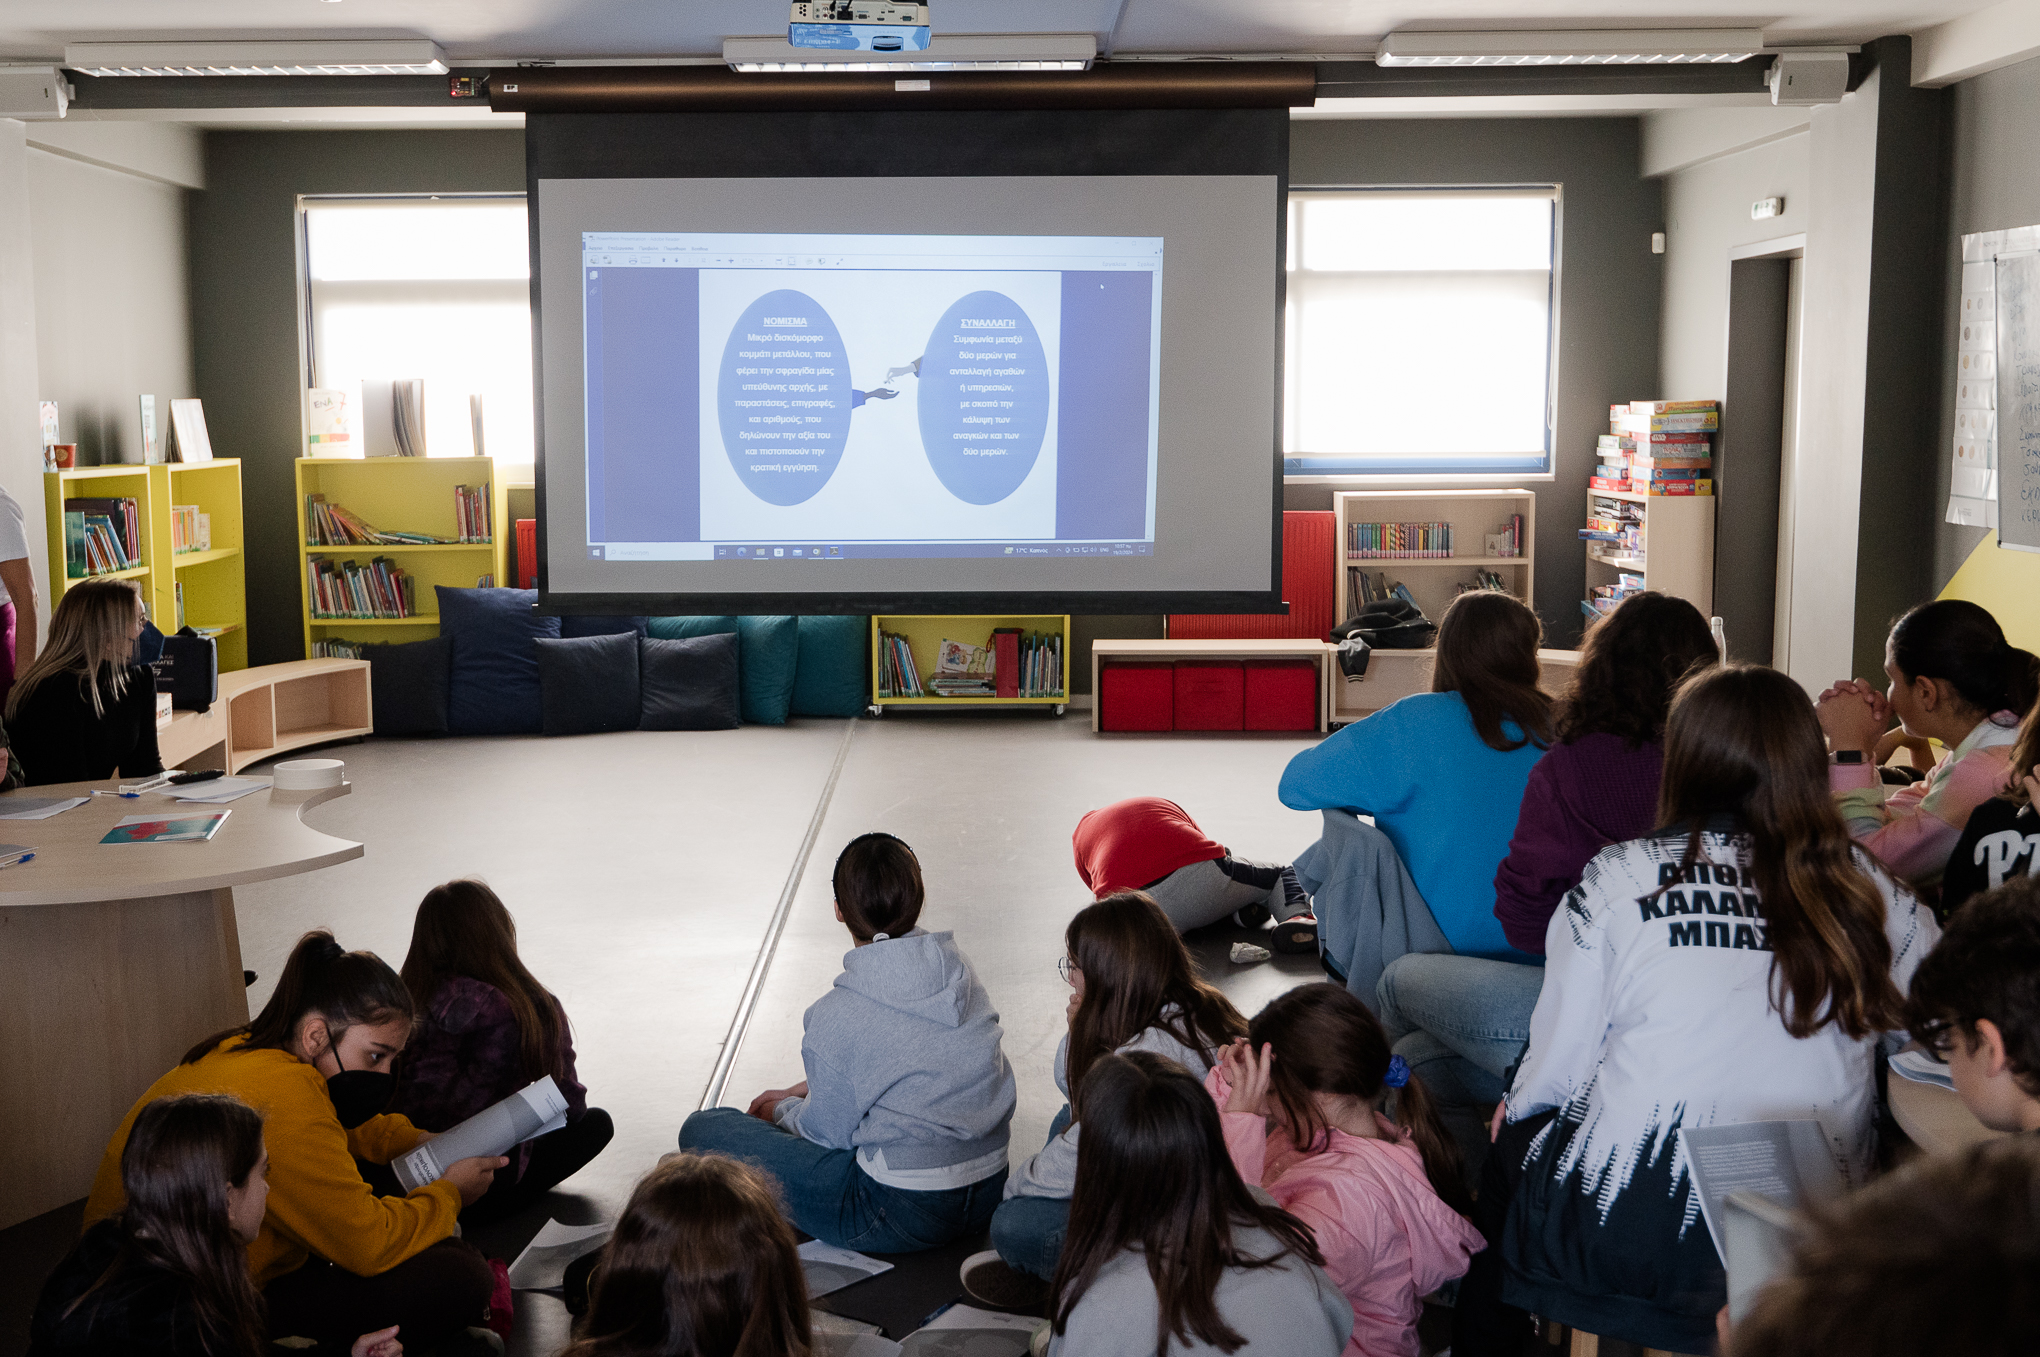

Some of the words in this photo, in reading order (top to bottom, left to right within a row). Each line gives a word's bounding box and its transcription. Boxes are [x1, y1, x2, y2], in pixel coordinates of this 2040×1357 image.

[763, 318, 807, 327] ΝΟΜΙΣΜΑ
[961, 319, 1016, 328] ΣΥΝΑΛΛΑΓΗ
[748, 334, 772, 343] Μικρό
[774, 334, 823, 343] δισκόμορφο
[954, 335, 993, 344] Συμφωνία
[996, 336, 1022, 344] μεταξύ
[740, 350, 770, 359] κομμάτι
[773, 350, 812, 359] μετάλλου,
[977, 352, 1002, 360] μερών
[736, 367, 758, 376] φέρει
[776, 367, 814, 376] σφραγίδα
[817, 367, 834, 376] μίας
[950, 368, 991, 376] ανταλλαγή
[994, 368, 1025, 376] αγαθών
[742, 383, 787, 392] υπεύθυνης
[789, 383, 816, 392] αρχής,
[960, 384, 965, 392] ή
[968, 384, 1014, 392] υπηρεσιών,
[735, 400, 789, 408] παραστάσεις,
[792, 400, 835, 408] επιγραφές,
[763, 416, 802, 424] αριθμούς,
[963, 416, 993, 425] κάλυψη
[740, 431, 780, 440] δηλώνουν
[798, 431, 815, 440] αξία
[953, 432, 988, 441] αναγκών
[981, 448, 1008, 457] μερών.
[751, 464, 780, 472] κρατική
[783, 464, 819, 472] εγγύηση.
